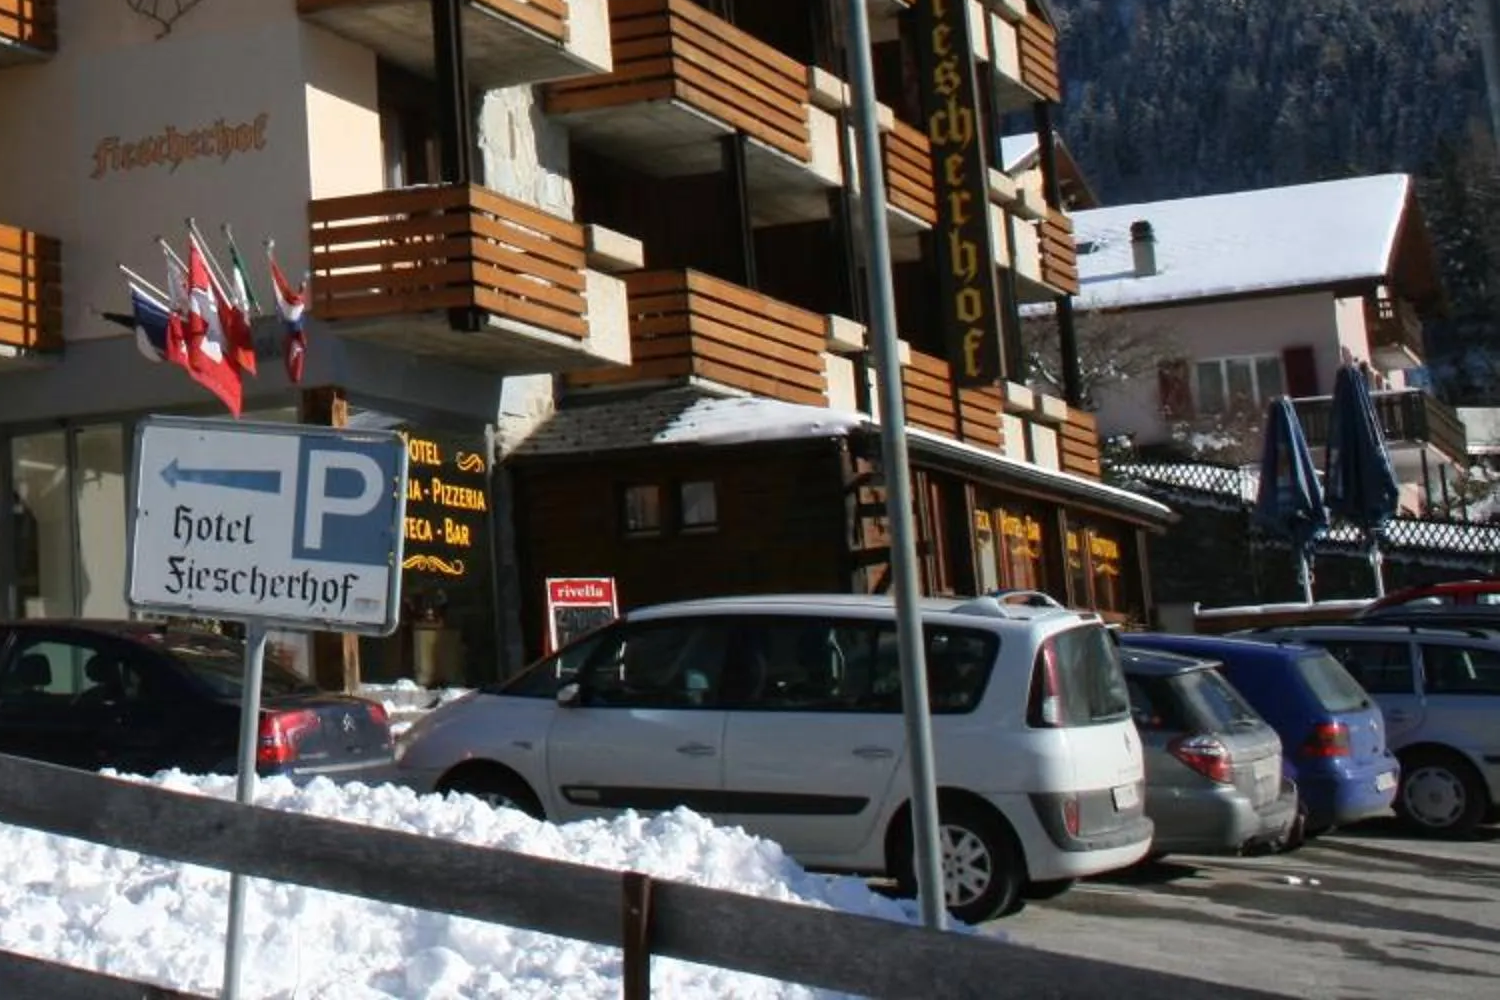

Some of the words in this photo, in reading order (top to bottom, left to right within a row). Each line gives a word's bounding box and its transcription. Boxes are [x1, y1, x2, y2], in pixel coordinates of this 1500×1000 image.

[403, 431, 441, 466] OTEL
[303, 449, 384, 549] P
[431, 477, 487, 512] PIZZERIA
[173, 504, 254, 548] Hotel
[445, 517, 471, 547] BAR
[165, 555, 360, 613] Fiescherhof
[557, 584, 604, 598] rivella
